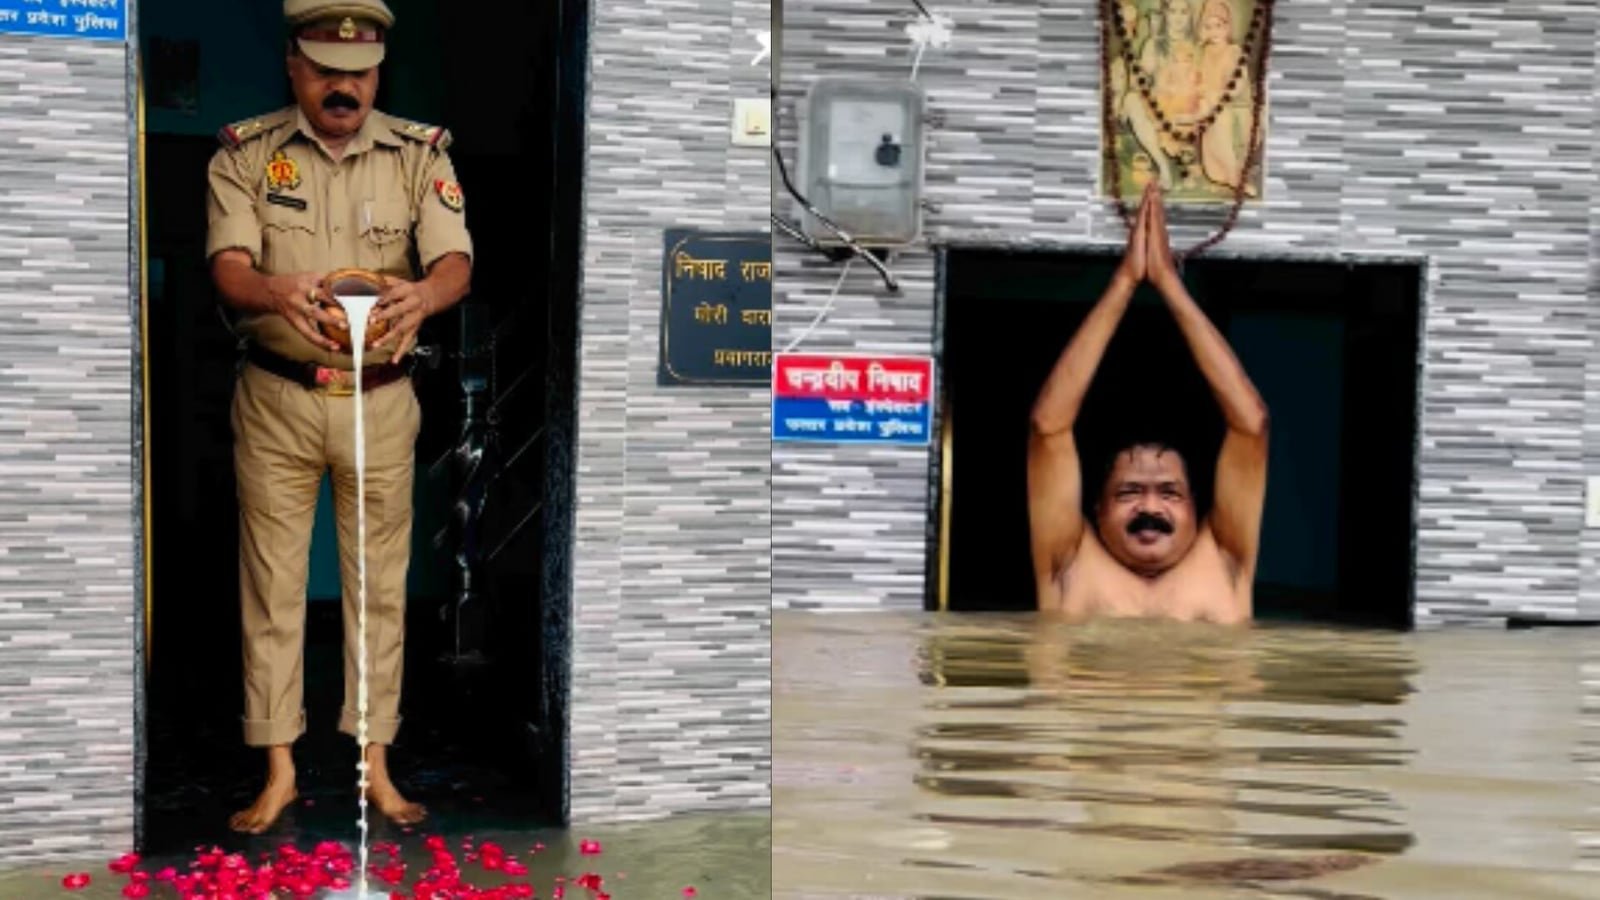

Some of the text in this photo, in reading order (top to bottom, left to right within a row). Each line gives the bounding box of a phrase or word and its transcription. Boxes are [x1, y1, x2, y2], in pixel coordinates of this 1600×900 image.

[675, 251, 728, 280] निषाद
[713, 349, 771, 368] प्रयागरा
[865, 361, 925, 394] निषाद
